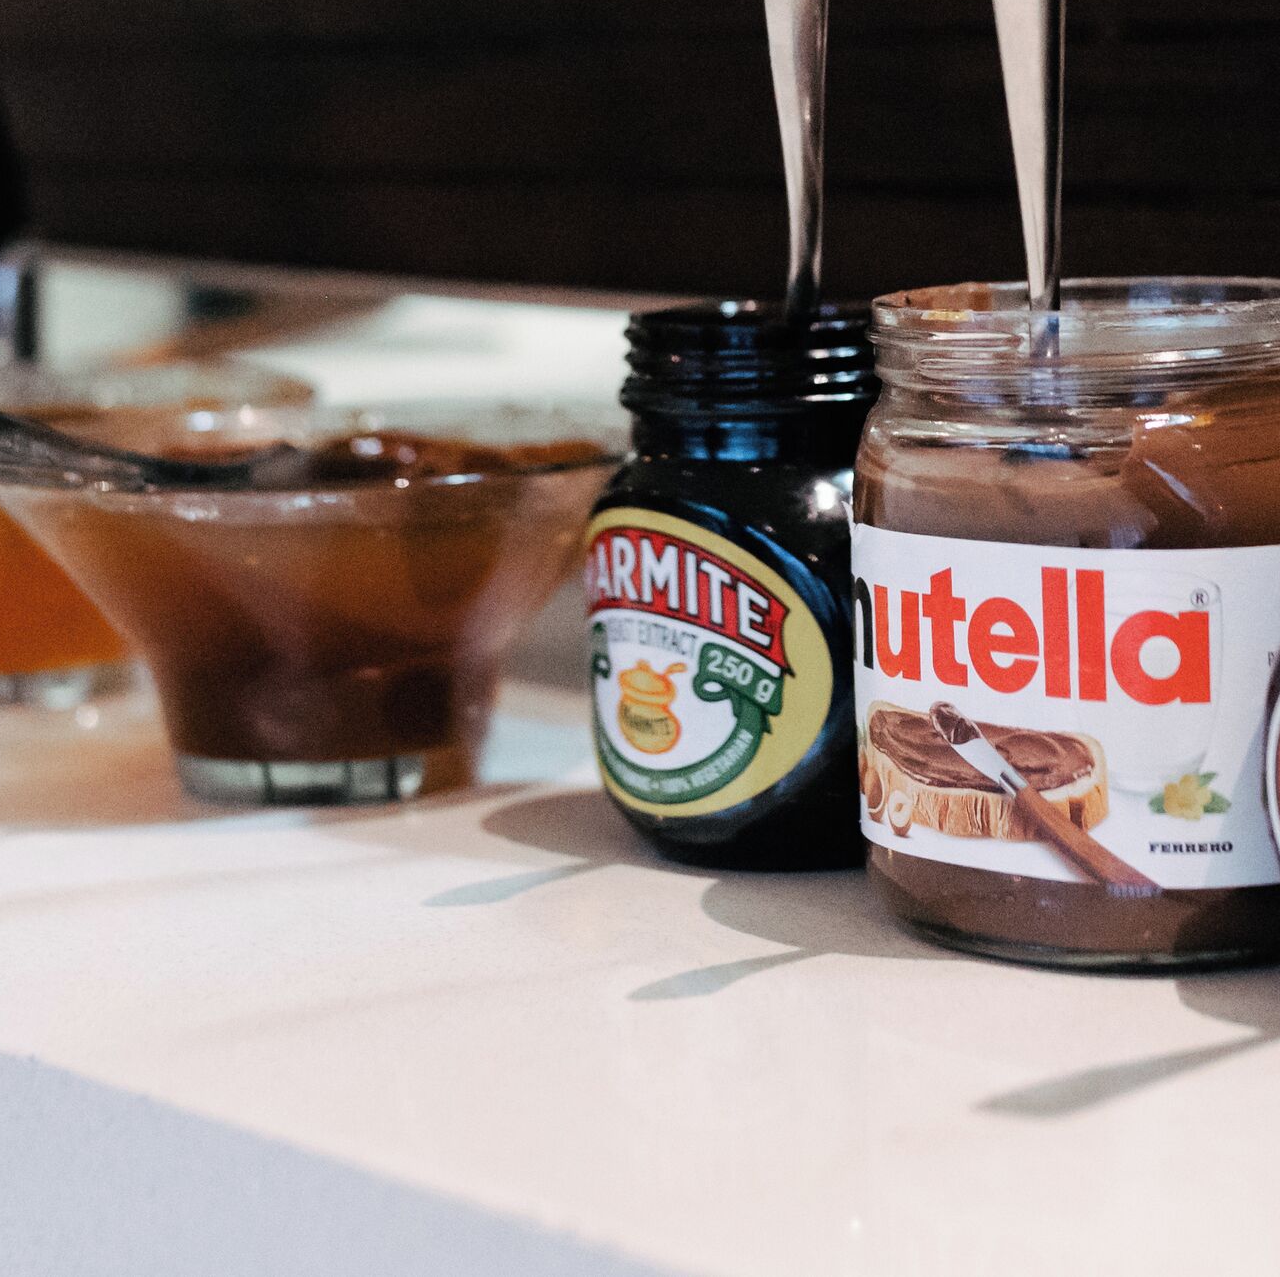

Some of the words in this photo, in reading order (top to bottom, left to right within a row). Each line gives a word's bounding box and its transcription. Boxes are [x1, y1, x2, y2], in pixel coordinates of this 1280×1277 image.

[853, 566, 1211, 706] nutella
[706, 649, 754, 686] 250
[753, 677, 777, 704] g
[1148, 840, 1234, 854] FERRERO
